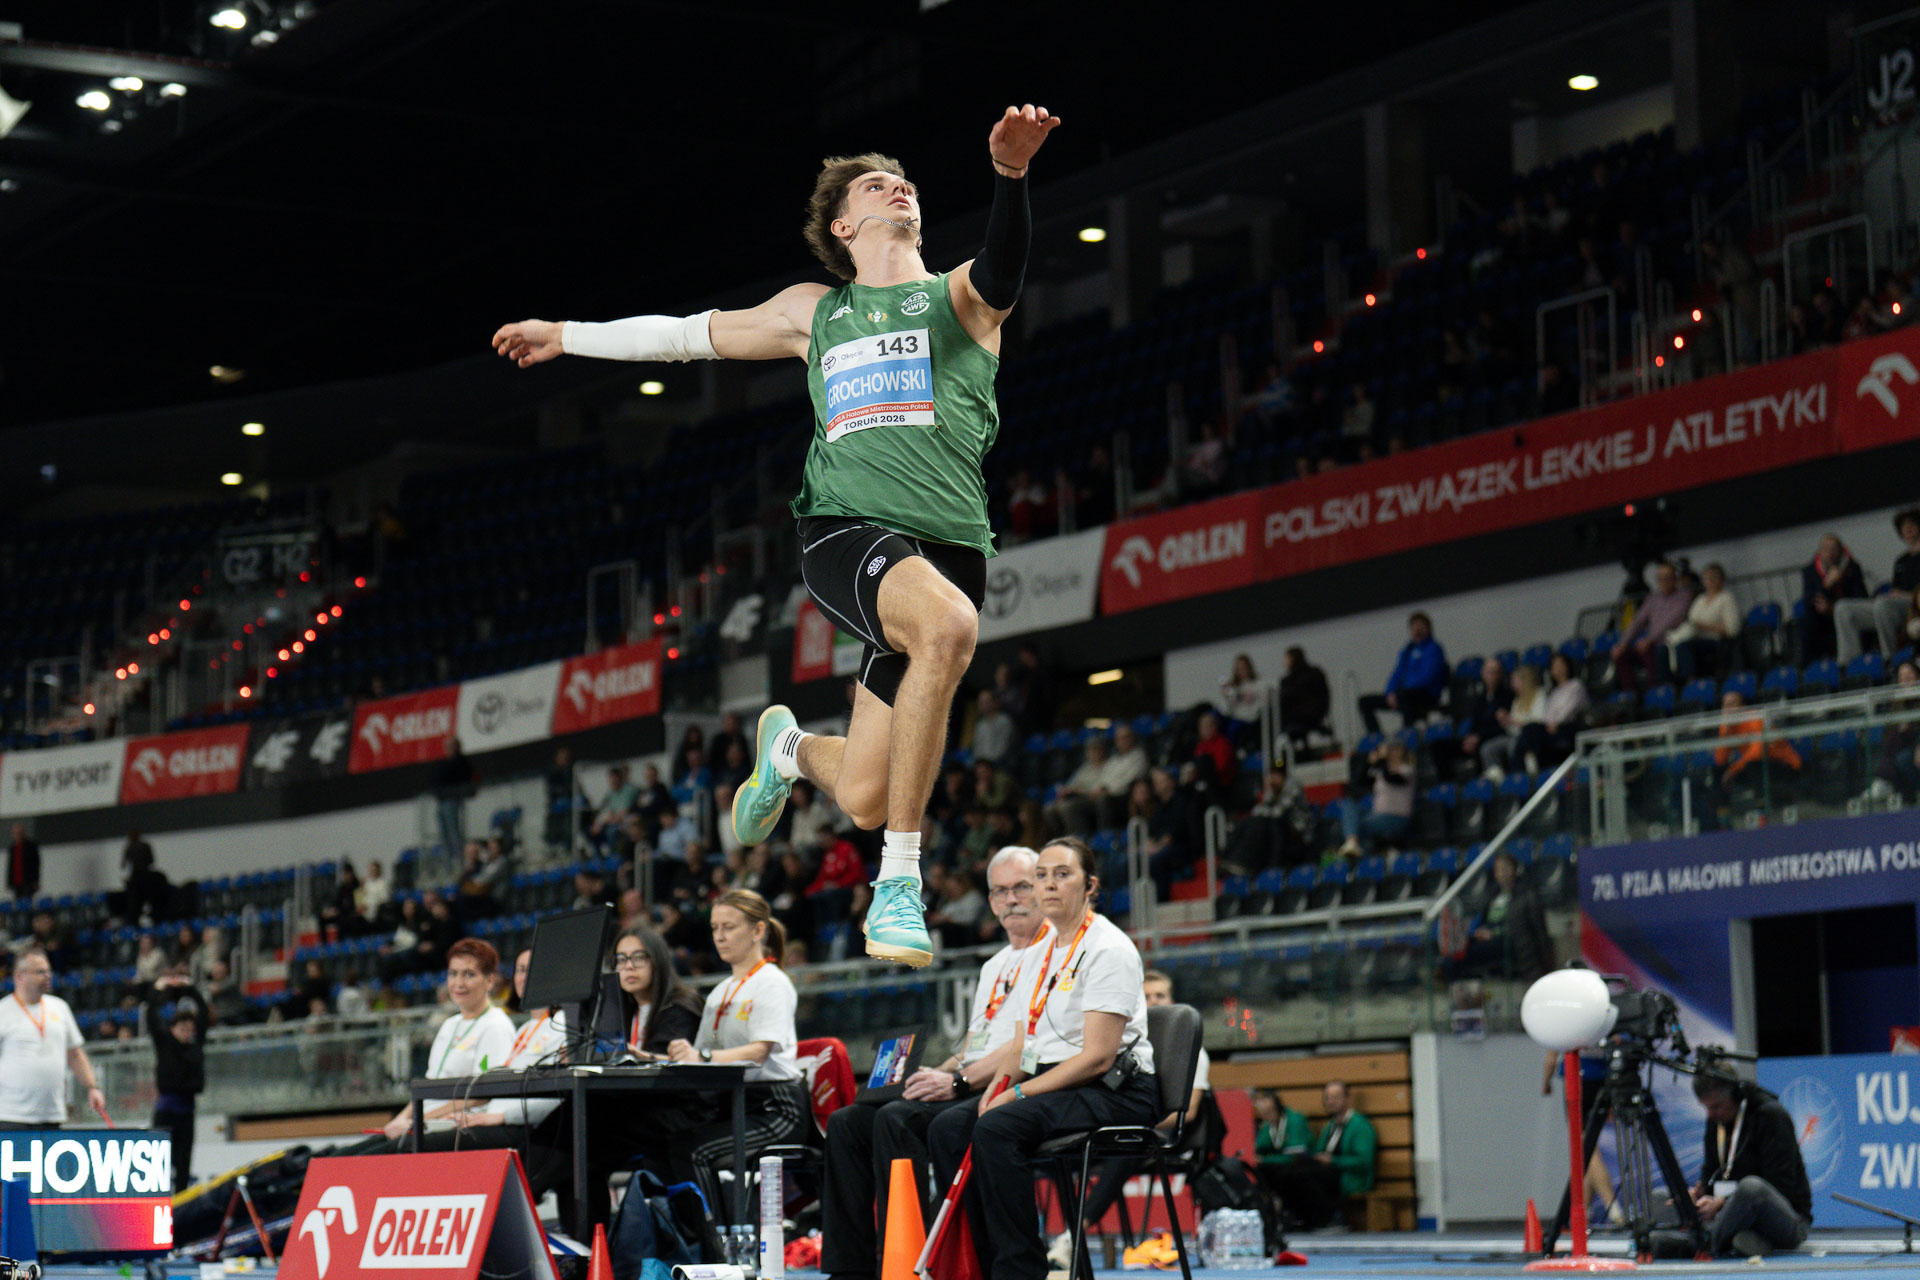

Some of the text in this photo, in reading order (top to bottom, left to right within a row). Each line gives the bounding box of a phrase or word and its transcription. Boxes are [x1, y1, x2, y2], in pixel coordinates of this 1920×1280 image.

[1867, 48, 1915, 110] J2
[877, 336, 918, 356] 143
[828, 369, 926, 408] GROCHOWSKI
[844, 415, 905, 430] TORUŃ 2026
[846, 408, 869, 418] Halowe
[870, 404, 909, 413] Mistrzostwa
[1265, 382, 1827, 548] POLSKI ZWIĄZEK LEKKIEJ ATLETYKI
[1158, 521, 1246, 572] ORLEN
[594, 661, 655, 701] ORLEN
[390, 708, 450, 744] ORLEN
[13, 763, 110, 793] TVP SPORT
[169, 744, 239, 778] ORLEN
[1622, 869, 1665, 899] PZLA
[1668, 861, 1744, 894] HALOWE
[1749, 848, 1876, 886] MISTRZOSTWA
[373, 1207, 475, 1257] ORLEN
